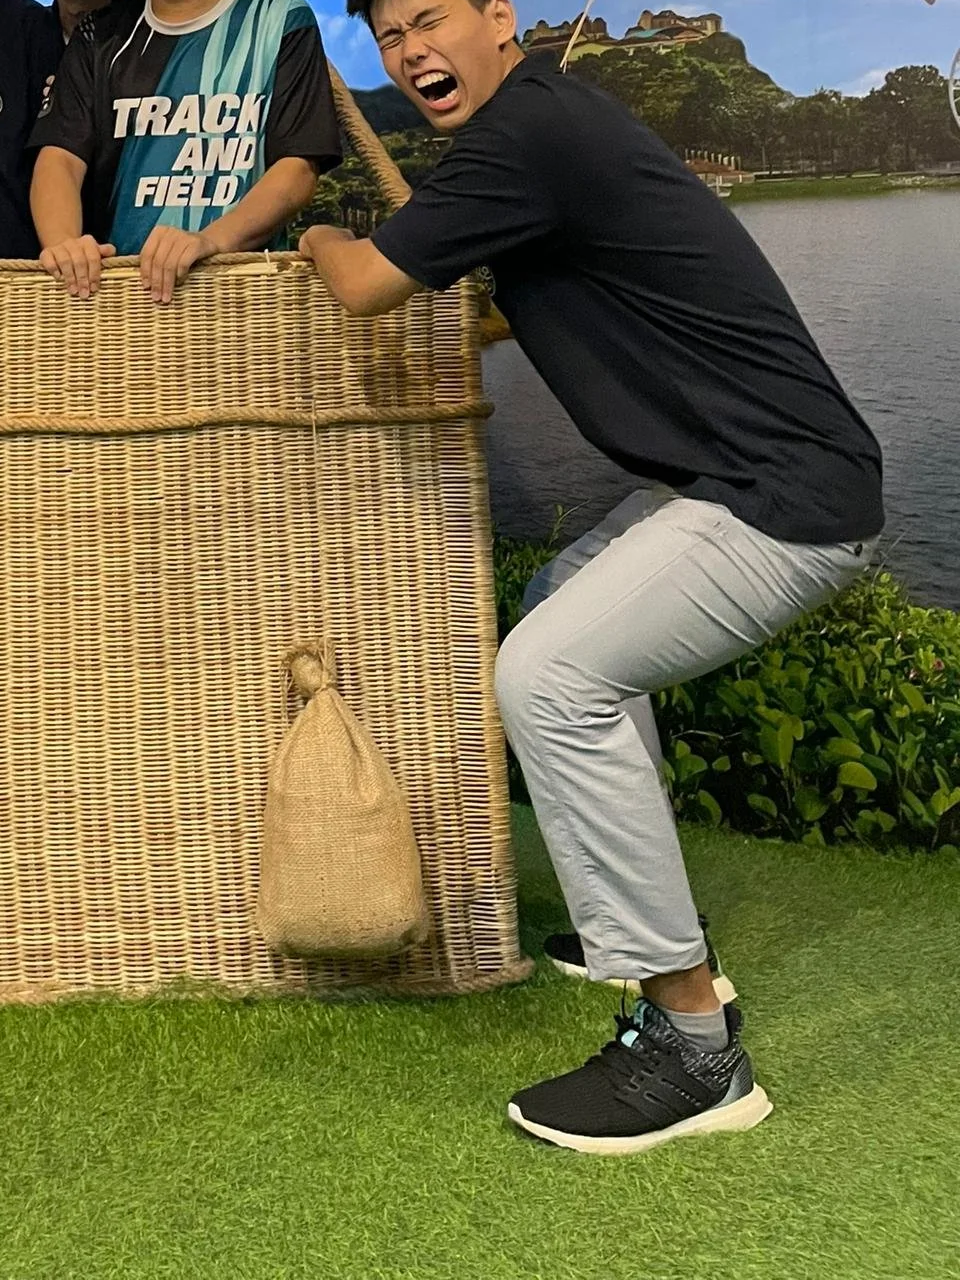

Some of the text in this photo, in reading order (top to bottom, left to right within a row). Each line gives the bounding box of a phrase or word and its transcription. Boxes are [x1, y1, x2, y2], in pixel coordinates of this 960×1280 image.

[113, 92, 266, 138] TRACK
[171, 136, 257, 171] AND
[134, 175, 239, 207] FIELD
